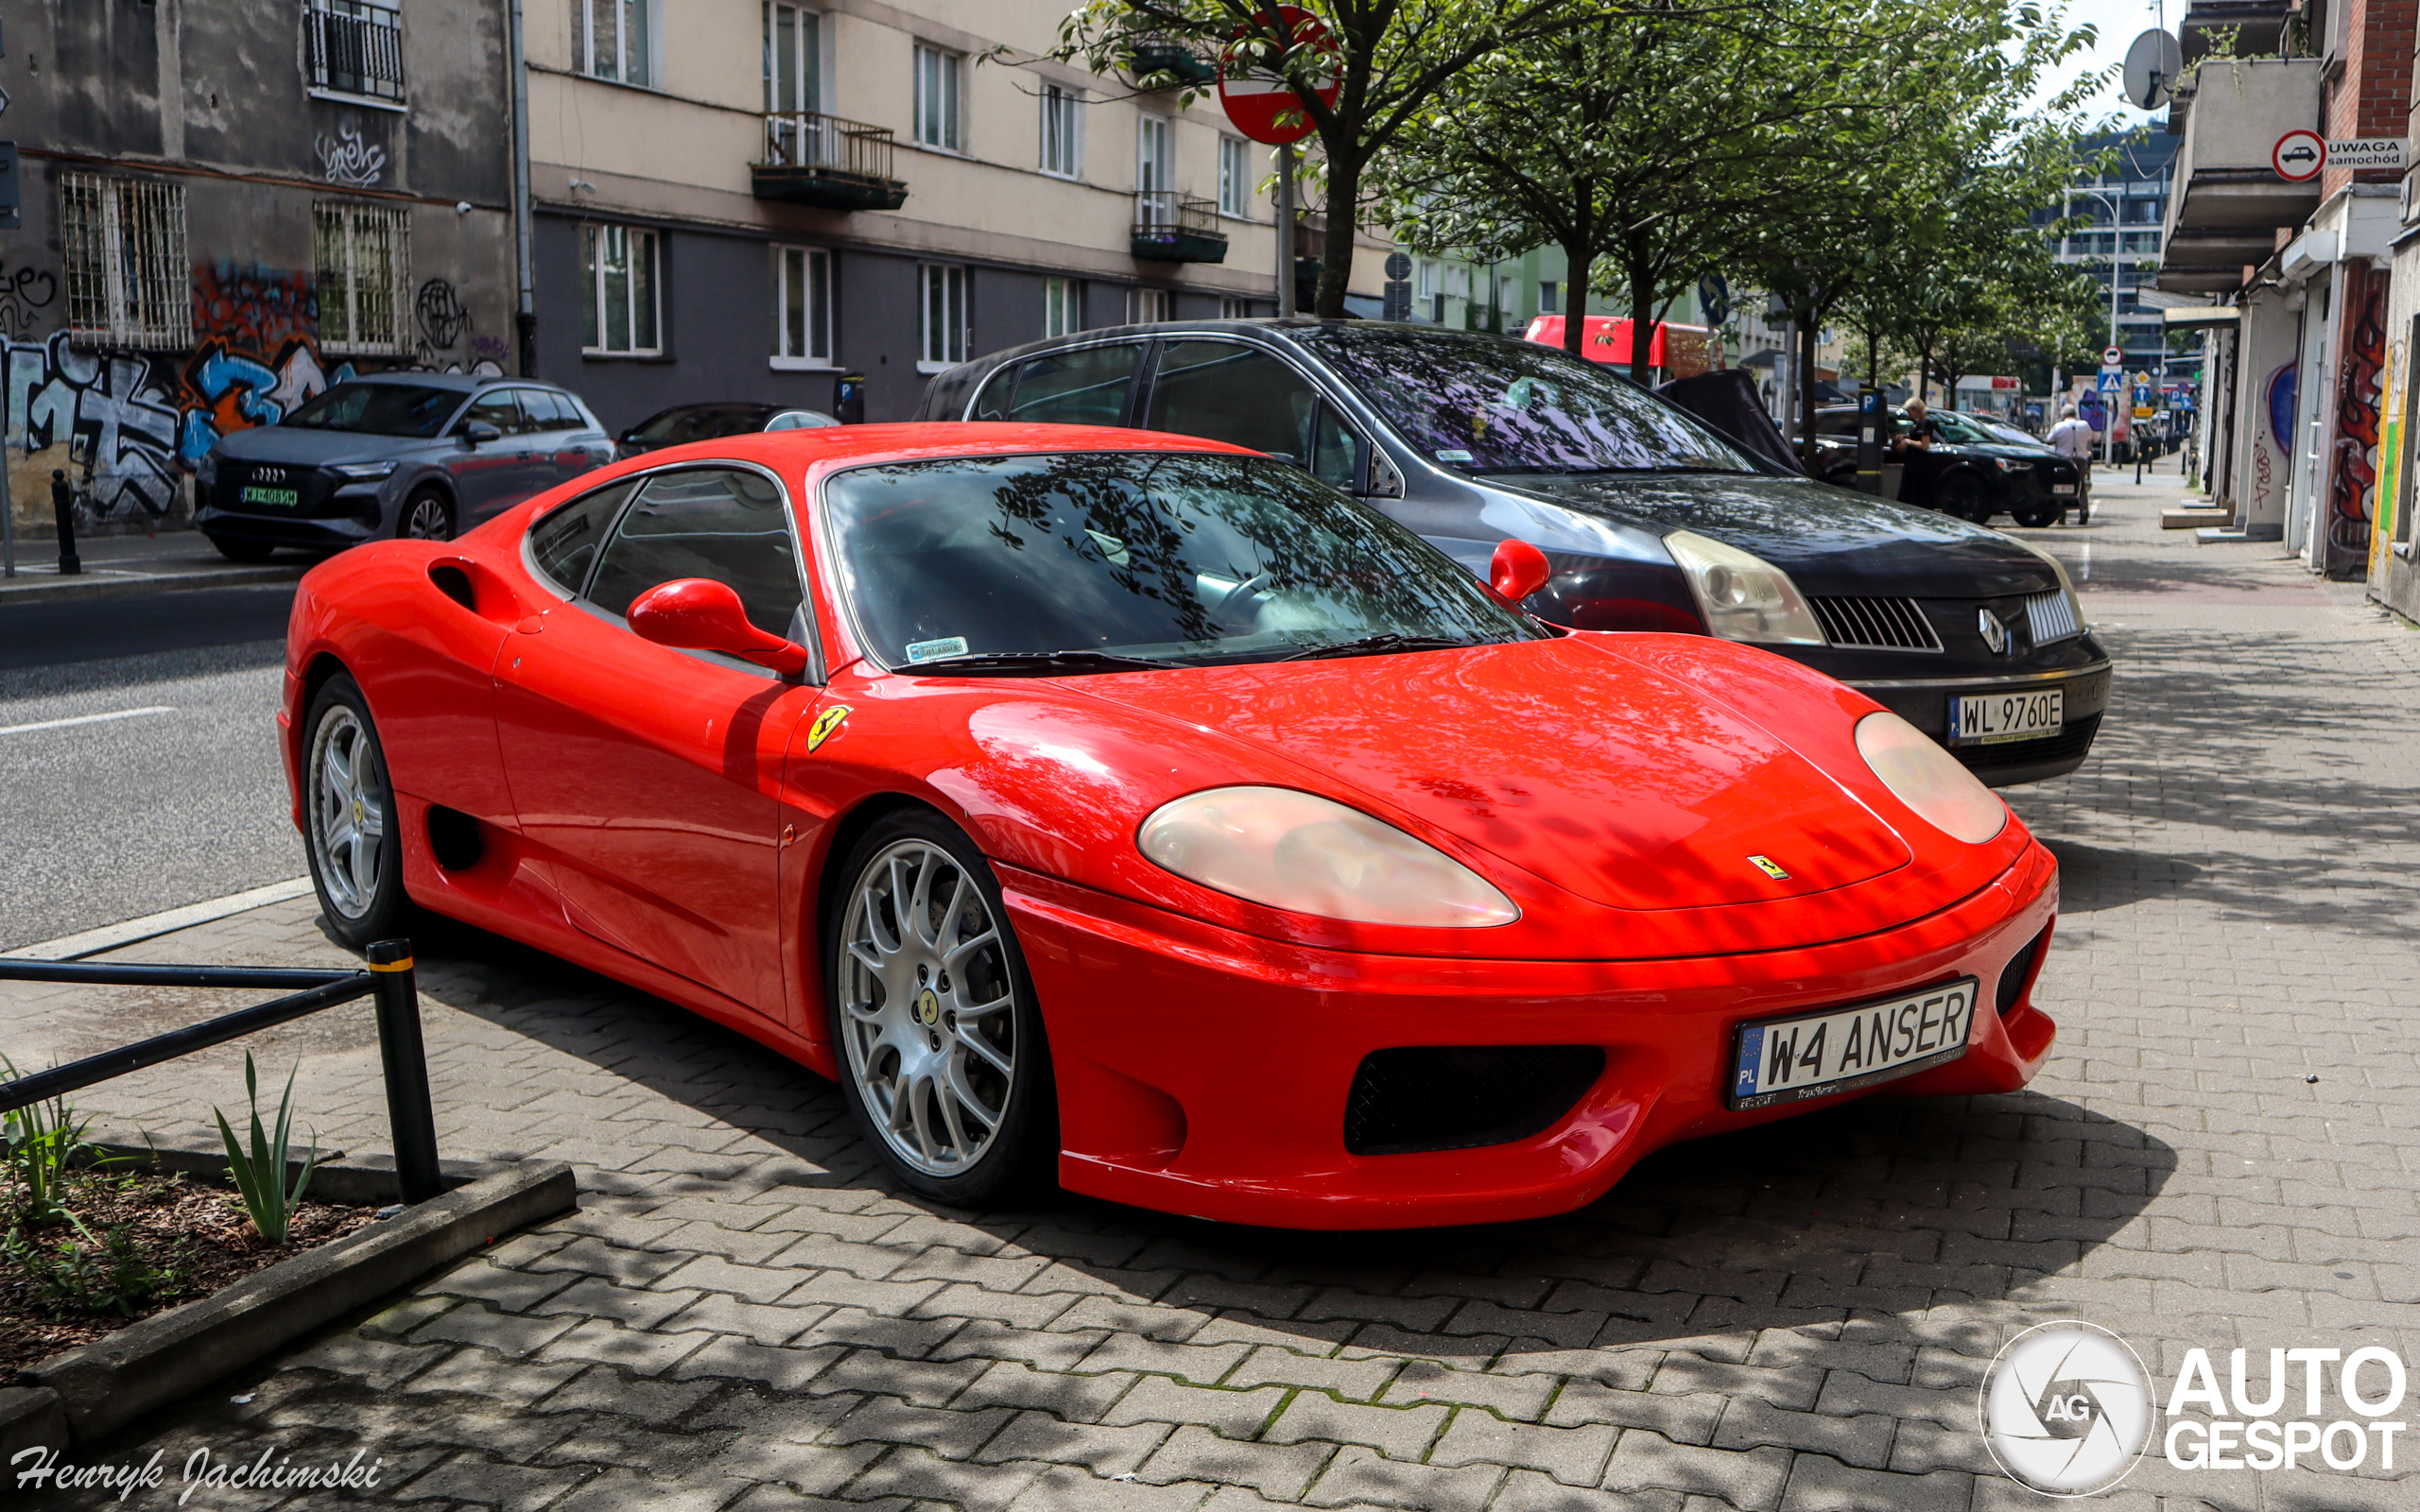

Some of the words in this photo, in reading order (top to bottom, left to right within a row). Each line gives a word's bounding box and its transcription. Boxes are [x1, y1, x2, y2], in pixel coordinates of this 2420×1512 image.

[2328, 141, 2399, 153] UWAGA
[2327, 153, 2400, 165] samochód
[1864, 395, 1874, 409] P
[1964, 699, 1994, 733] WL
[2003, 694, 2061, 731] 9760E
[1768, 1022, 1827, 1086] W4
[1839, 991, 1965, 1072] ANSER
[1738, 1069, 1754, 1085] PL
